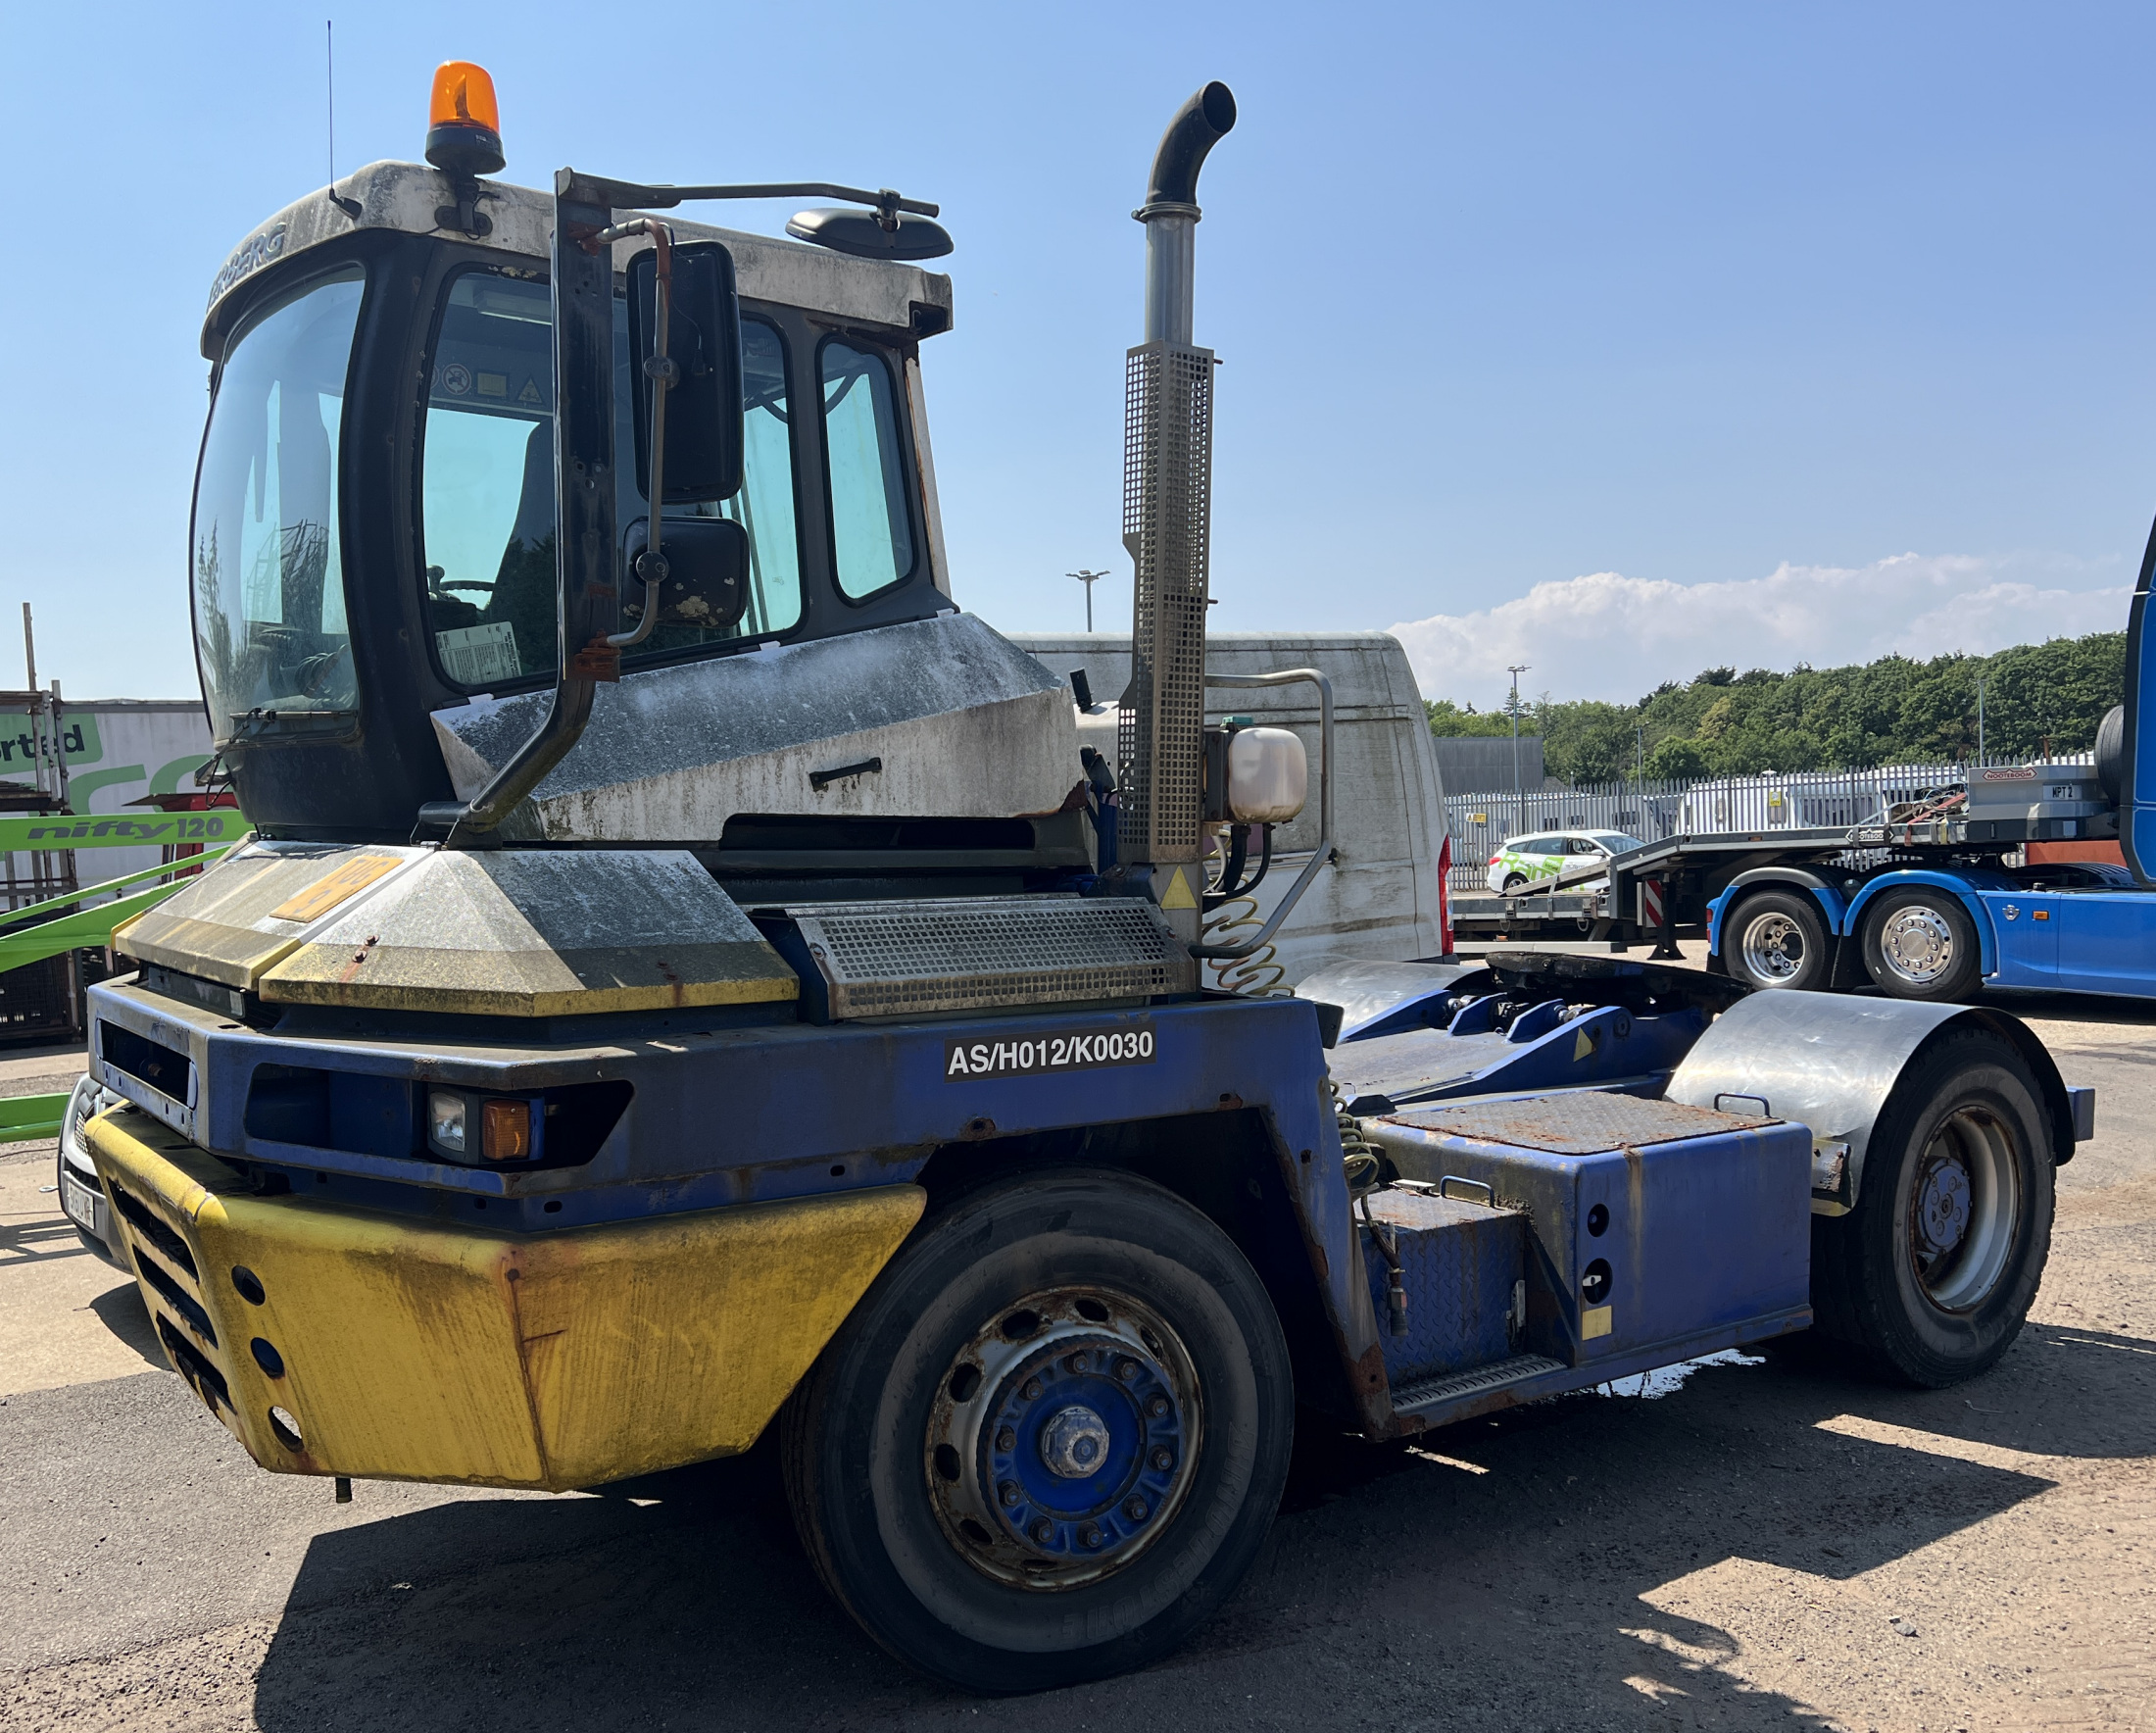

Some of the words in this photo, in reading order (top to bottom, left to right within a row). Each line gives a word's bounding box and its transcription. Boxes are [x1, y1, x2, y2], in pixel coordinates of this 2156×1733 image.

[207, 223, 287, 314] ERBERG
[328, 859, 390, 885] TUG
[948, 1031, 1153, 1075] AS/H012/K0030
